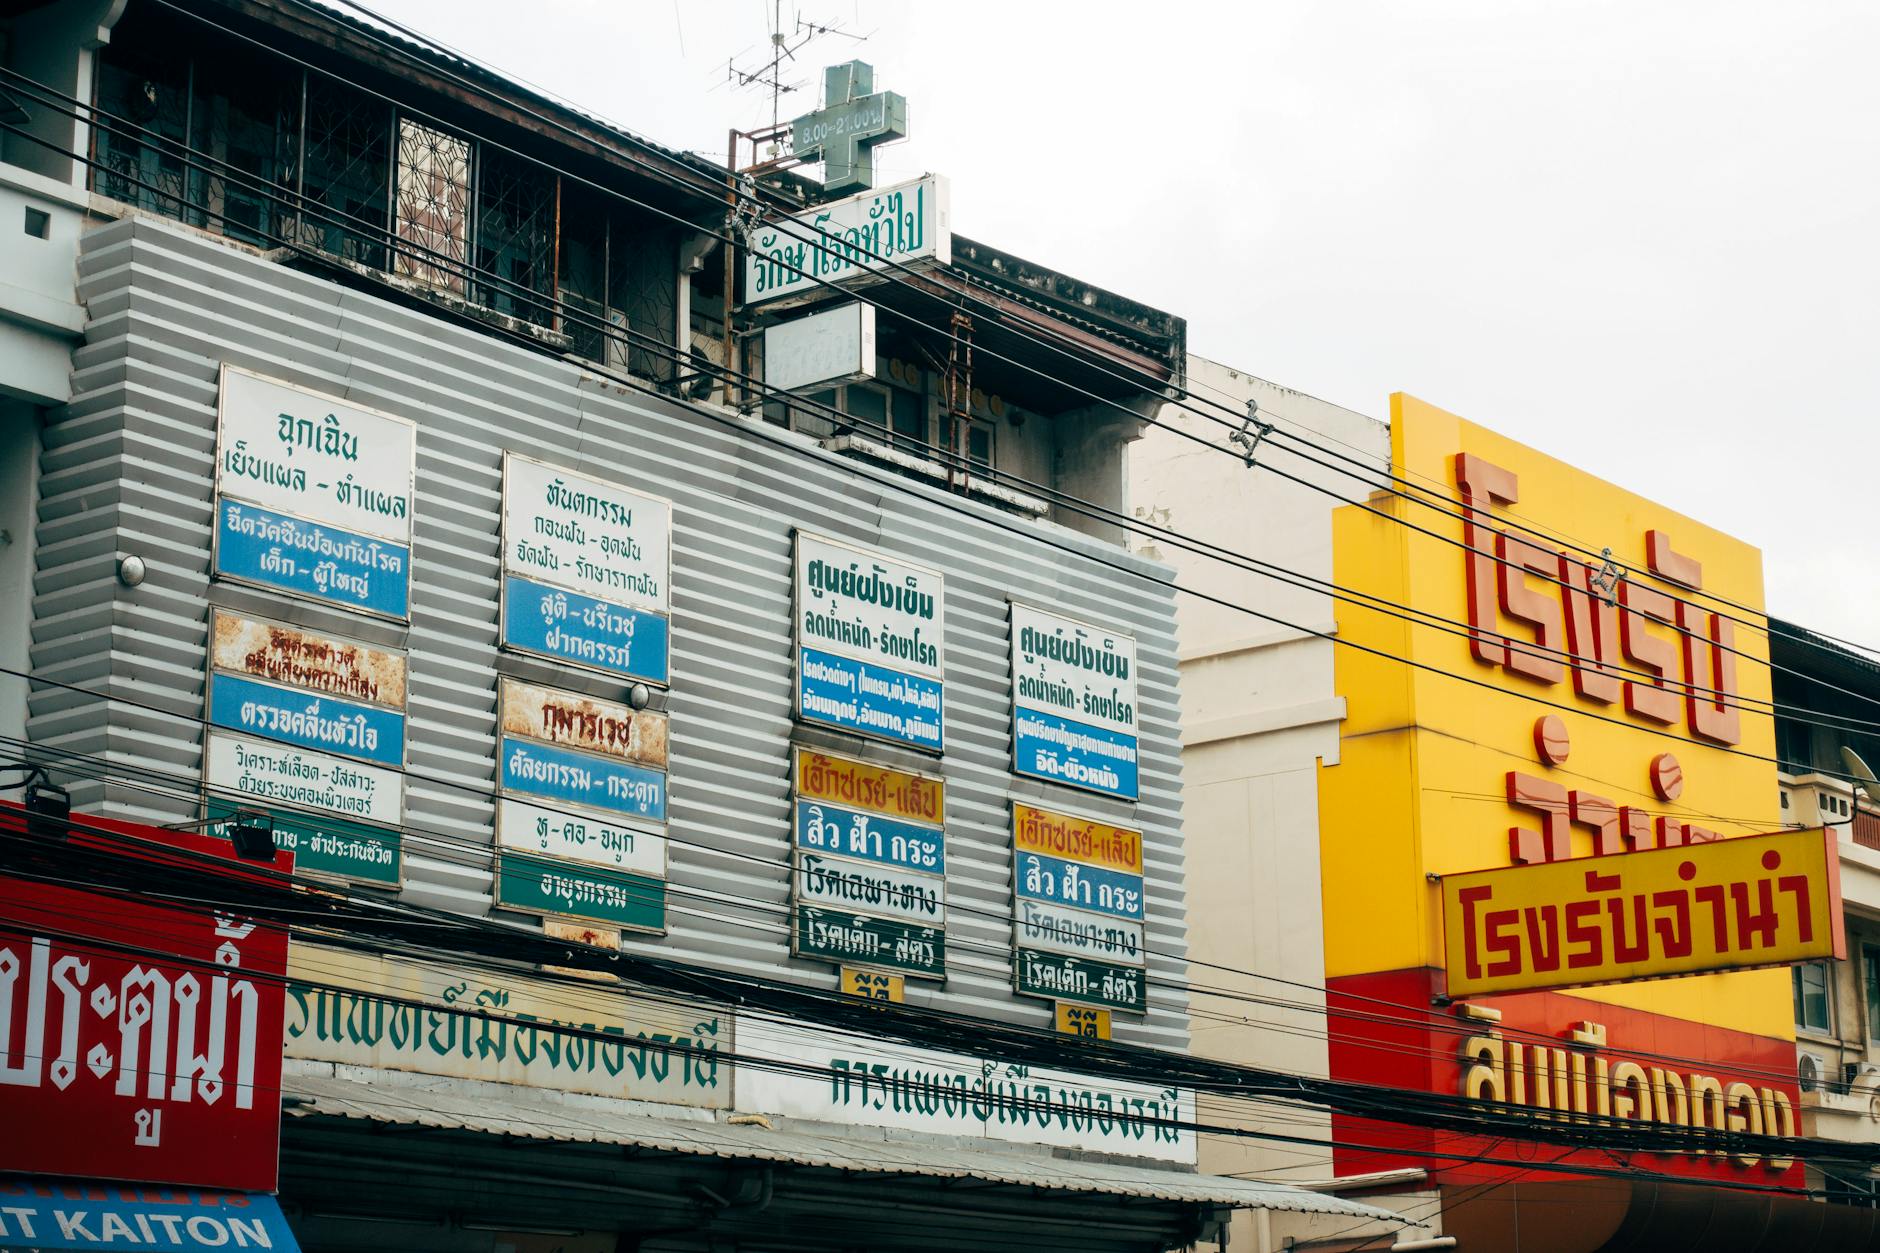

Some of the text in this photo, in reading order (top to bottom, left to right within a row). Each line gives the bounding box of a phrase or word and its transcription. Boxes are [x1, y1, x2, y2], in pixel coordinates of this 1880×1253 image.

[753, 185, 923, 293] รักษาโรคทั่วไป
[278, 413, 358, 461] ฉุกเฉิน
[225, 440, 306, 492] เย็บแผล
[336, 474, 406, 519] ทำแผล
[547, 478, 632, 528] ทันตกรรม
[227, 505, 401, 574] ฉีดวัคซีนป้องกันโรค
[601, 535, 641, 561] อุดฟัน
[260, 549, 294, 576] เด็ก
[313, 562, 369, 599] ผู้ใหญ่
[517, 539, 558, 571] จัดฟัน
[575, 555, 657, 598] รักษารากฟัน
[808, 559, 934, 620] ศูนย์ฝังเข็ม
[540, 592, 567, 625] สูติ
[583, 604, 636, 638] นรีเวช
[1455, 451, 1741, 746] โรงรับ
[546, 625, 631, 667] ฝากครรภ์
[805, 599, 872, 650] ลดน้ำหนัก
[880, 623, 937, 667] รักษาโรค
[1020, 626, 1129, 681] ศูนย์ฝังเข็ม
[1019, 663, 1075, 709] ลดน้ำหนัก
[1084, 685, 1133, 725] รักษาโรค
[241, 699, 378, 751] ตรวจคลื่นหัวใจ
[235, 744, 319, 781] วิเคราะห์เลือด
[509, 747, 591, 792] ศัลยกรรม
[607, 775, 659, 813] กระดูก
[239, 770, 373, 815] ด้วยระบบคอมพิวเตอร์
[536, 816, 549, 849] หู
[600, 829, 634, 863] จมูก
[807, 805, 937, 868] สิว ฝ้า กระ
[540, 873, 627, 908] อายุรกรรม
[803, 854, 936, 916] โรคเฉพาะทาง
[1026, 855, 1138, 913] สิว ฝ้า กระ
[1022, 901, 1137, 957] โรคเฉพาะทาง
[1458, 849, 1813, 980] โรงรับจำนำ
[829, 1058, 1179, 1144] การแพทย์เมืองทองธานี
[53, 1209, 273, 1250] KAITON
